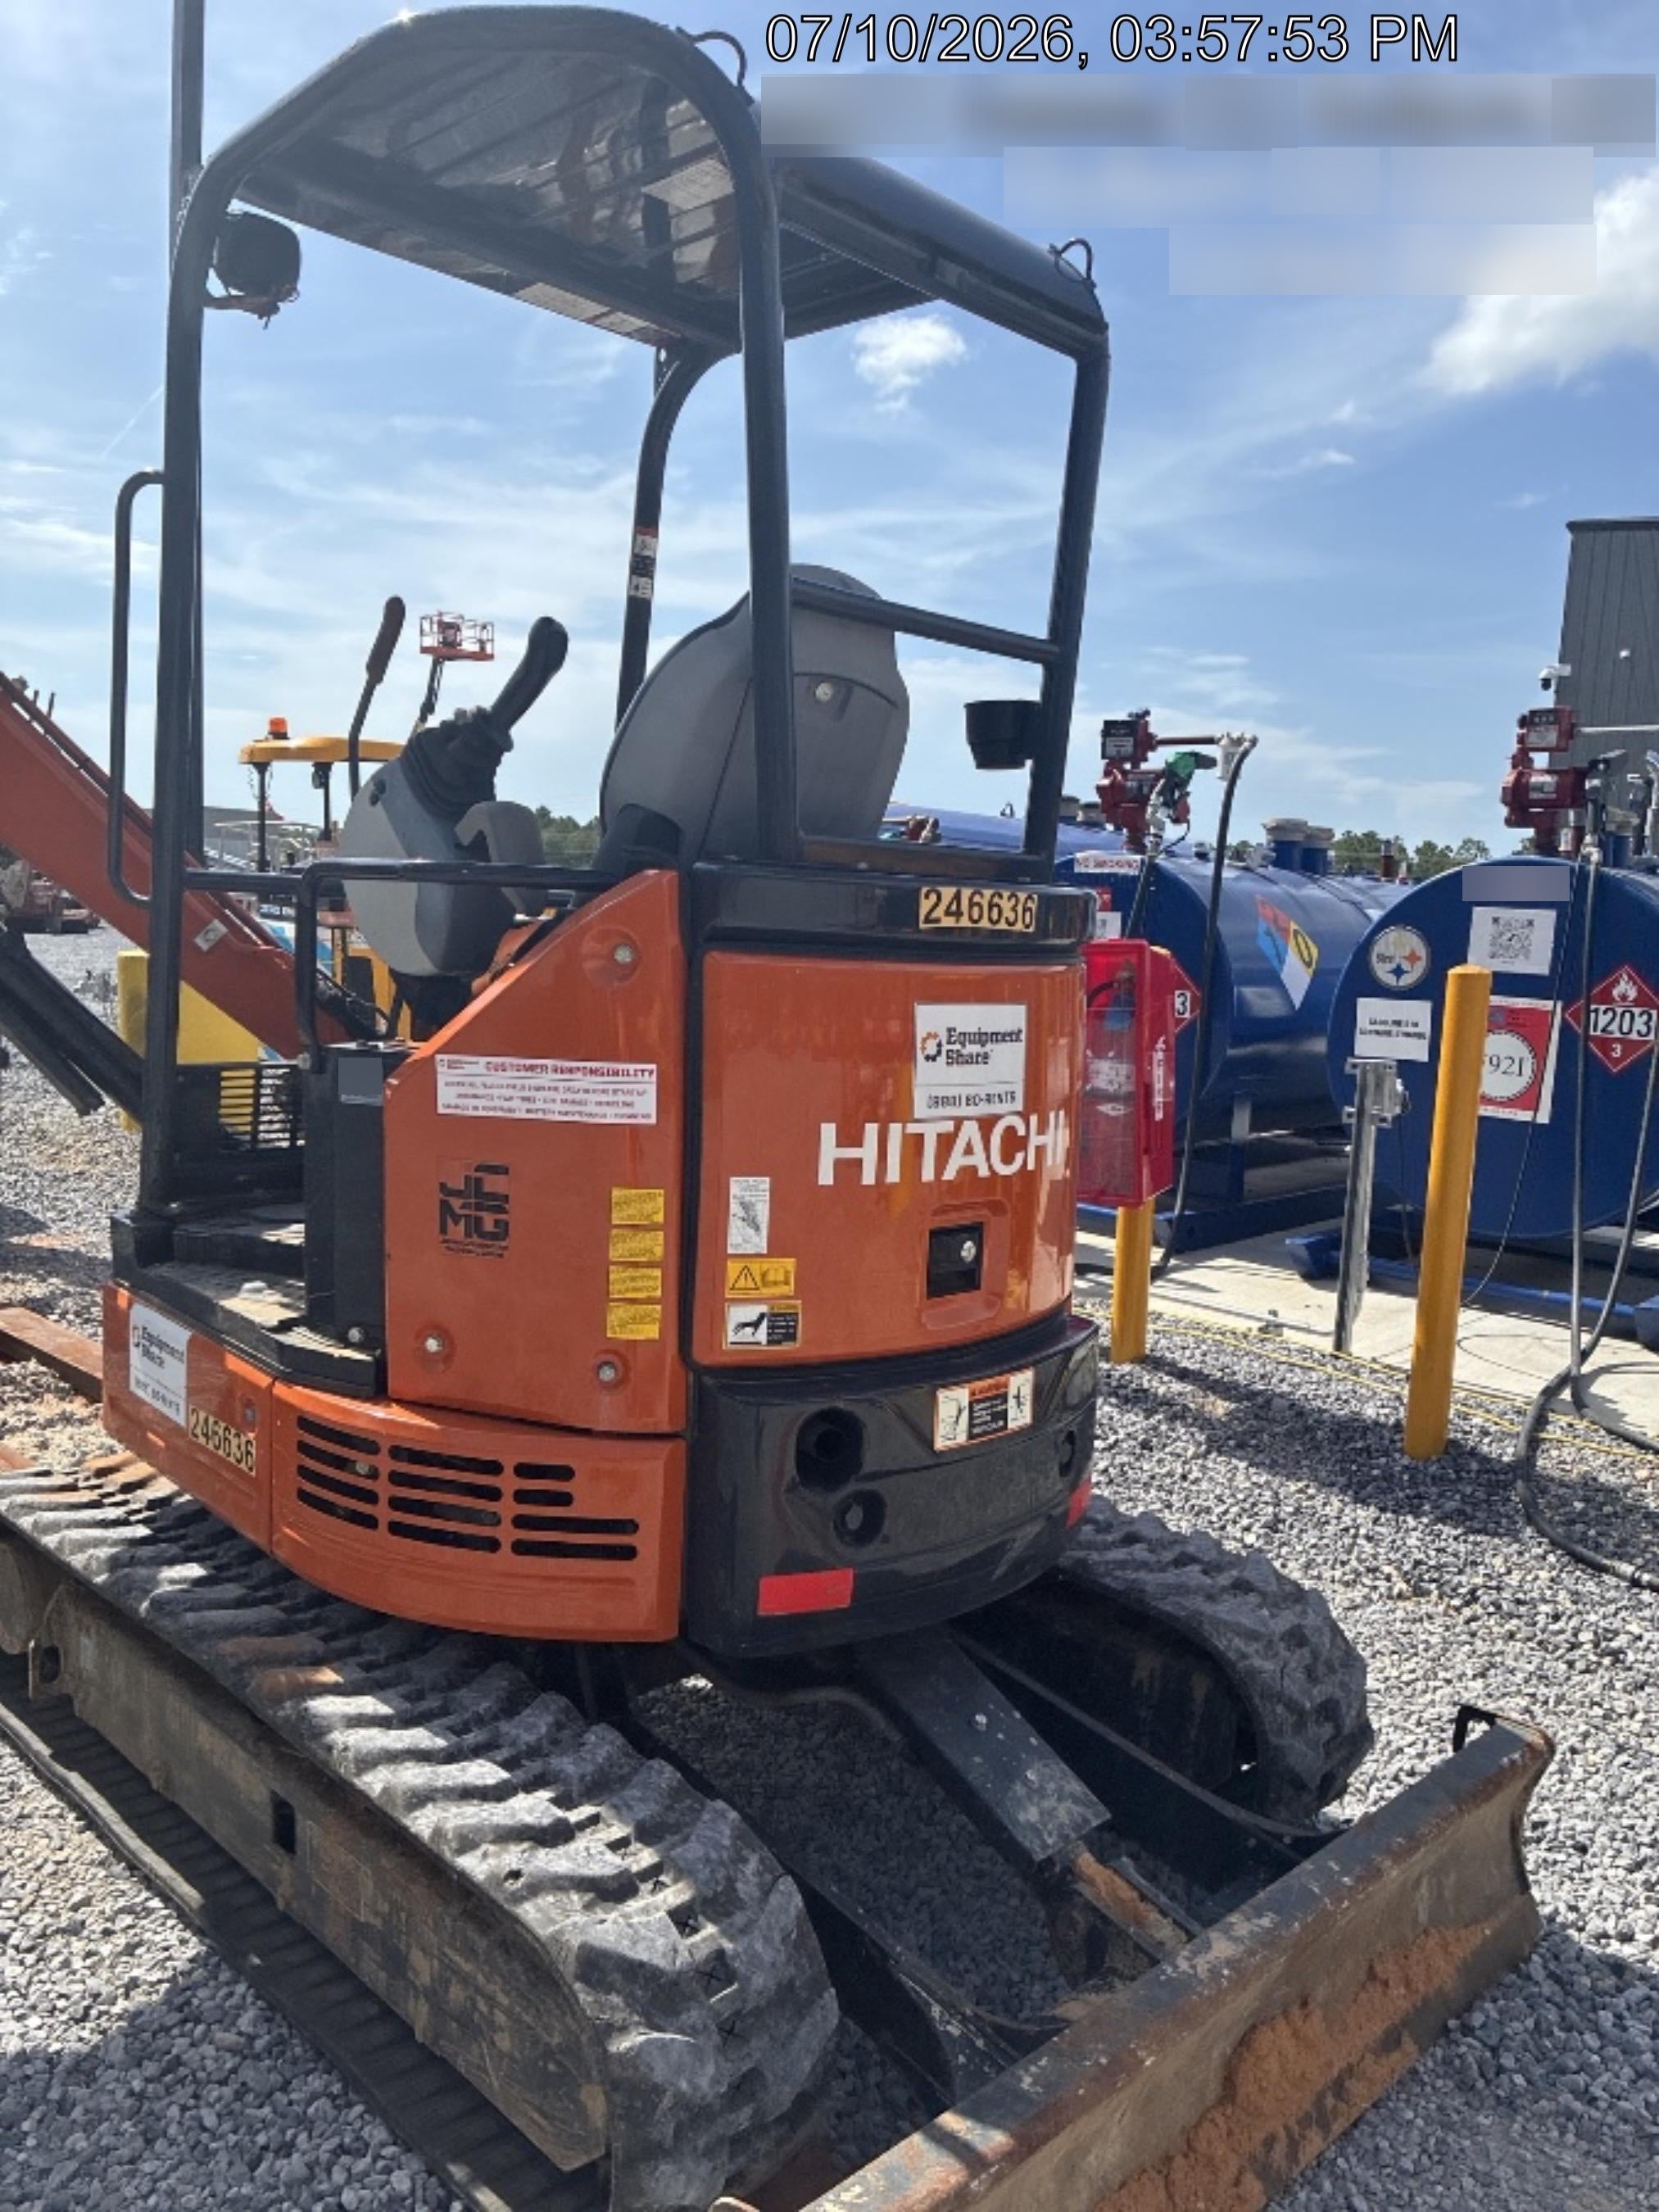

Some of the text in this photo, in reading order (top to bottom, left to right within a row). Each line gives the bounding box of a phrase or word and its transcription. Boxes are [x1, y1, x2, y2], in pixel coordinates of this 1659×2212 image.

[922, 888, 1036, 930] 246636
[1176, 992, 1188, 1017] 3
[1590, 1008, 1652, 1038] 1203
[945, 1027, 1023, 1048] Equipment
[1611, 1043, 1622, 1058] 3
[945, 1049, 990, 1066] Share
[818, 1109, 1070, 1185] HITACHI
[190, 1407, 255, 1472] 246636
